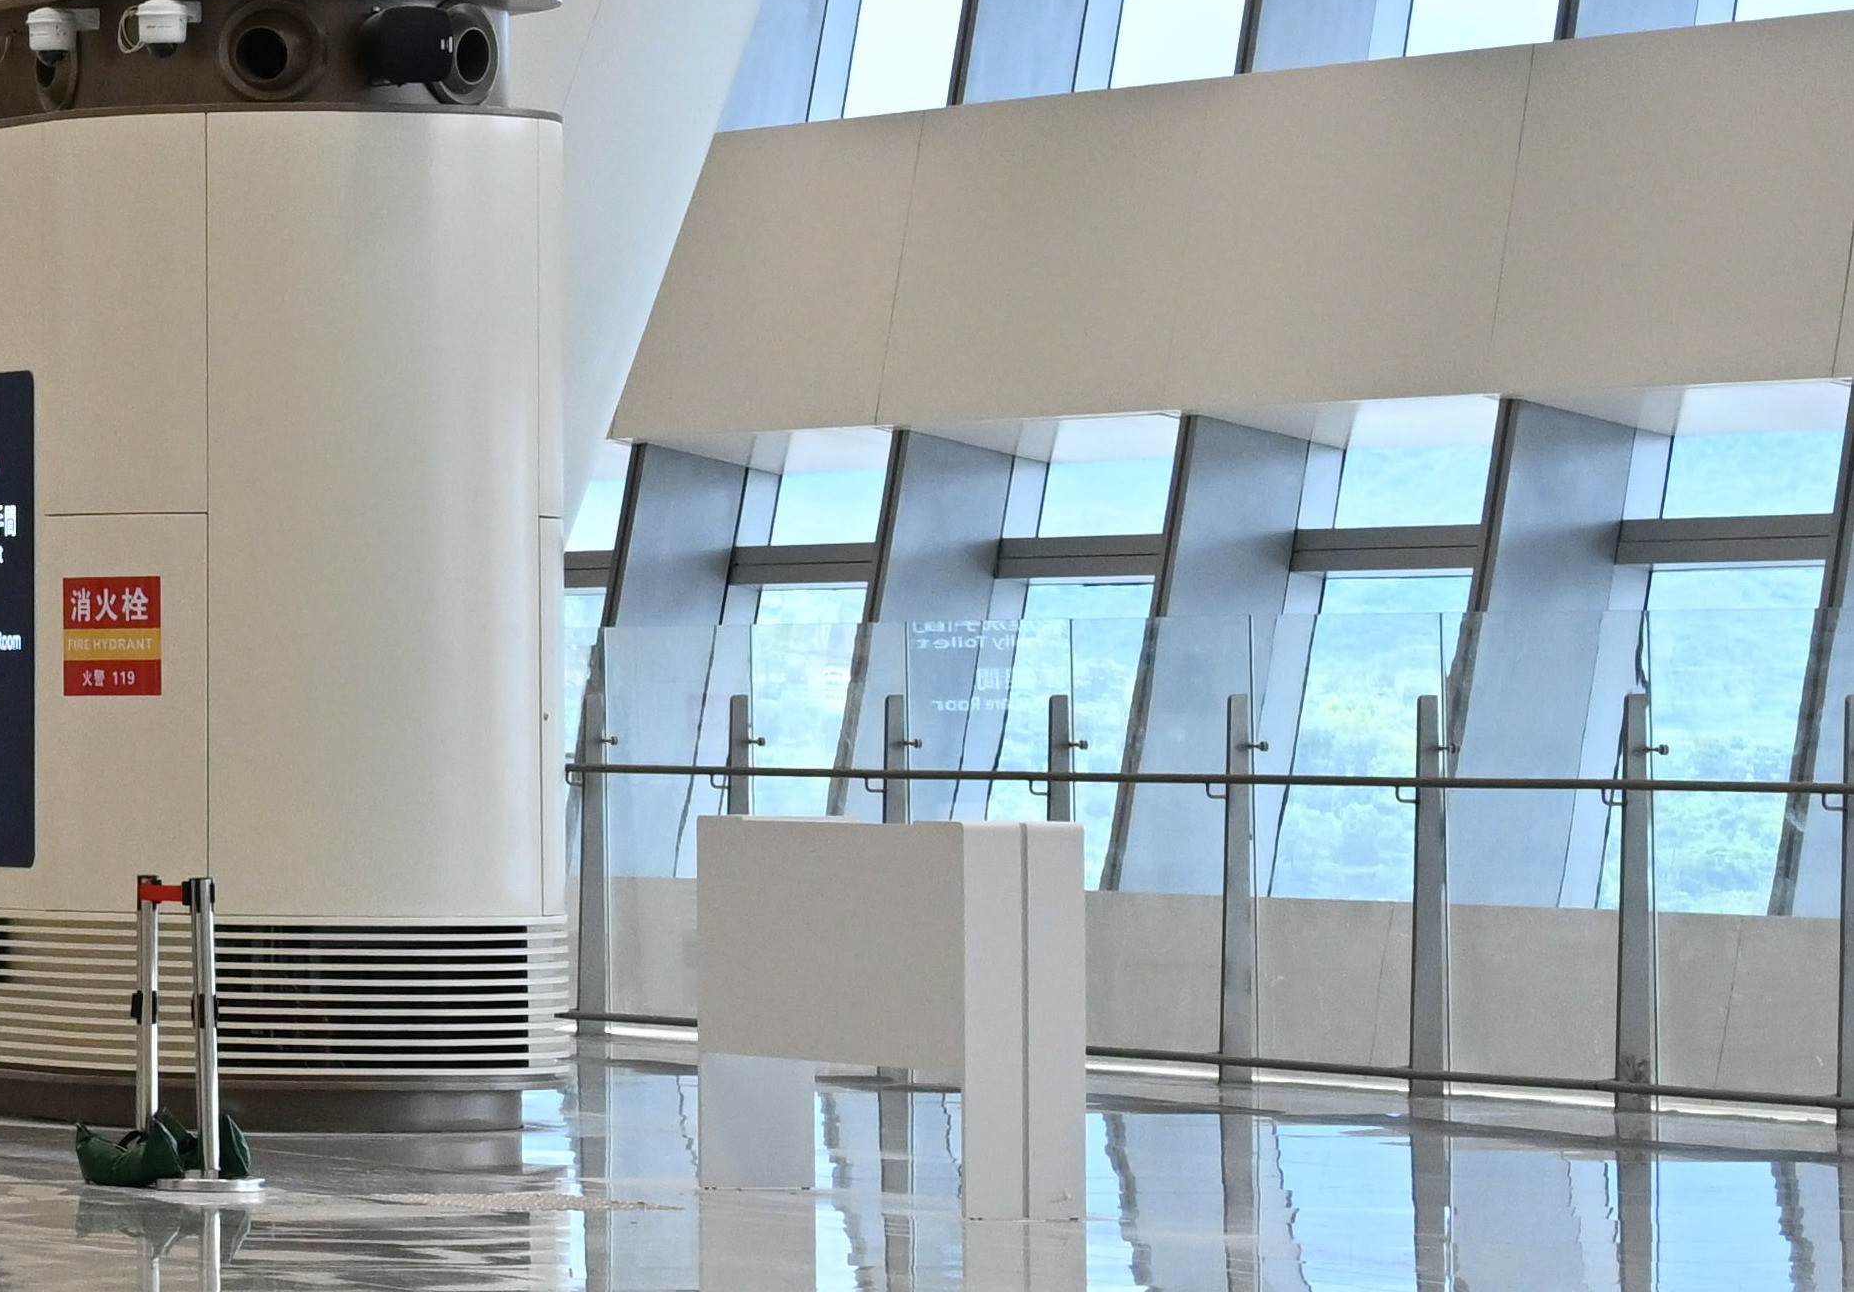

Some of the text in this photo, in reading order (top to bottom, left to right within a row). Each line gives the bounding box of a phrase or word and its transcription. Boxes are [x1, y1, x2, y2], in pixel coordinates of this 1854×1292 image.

[70, 587, 149, 622] 消火栓
[68, 638, 153, 650] FIRE HYDRANT
[112, 670, 135, 685] 119
